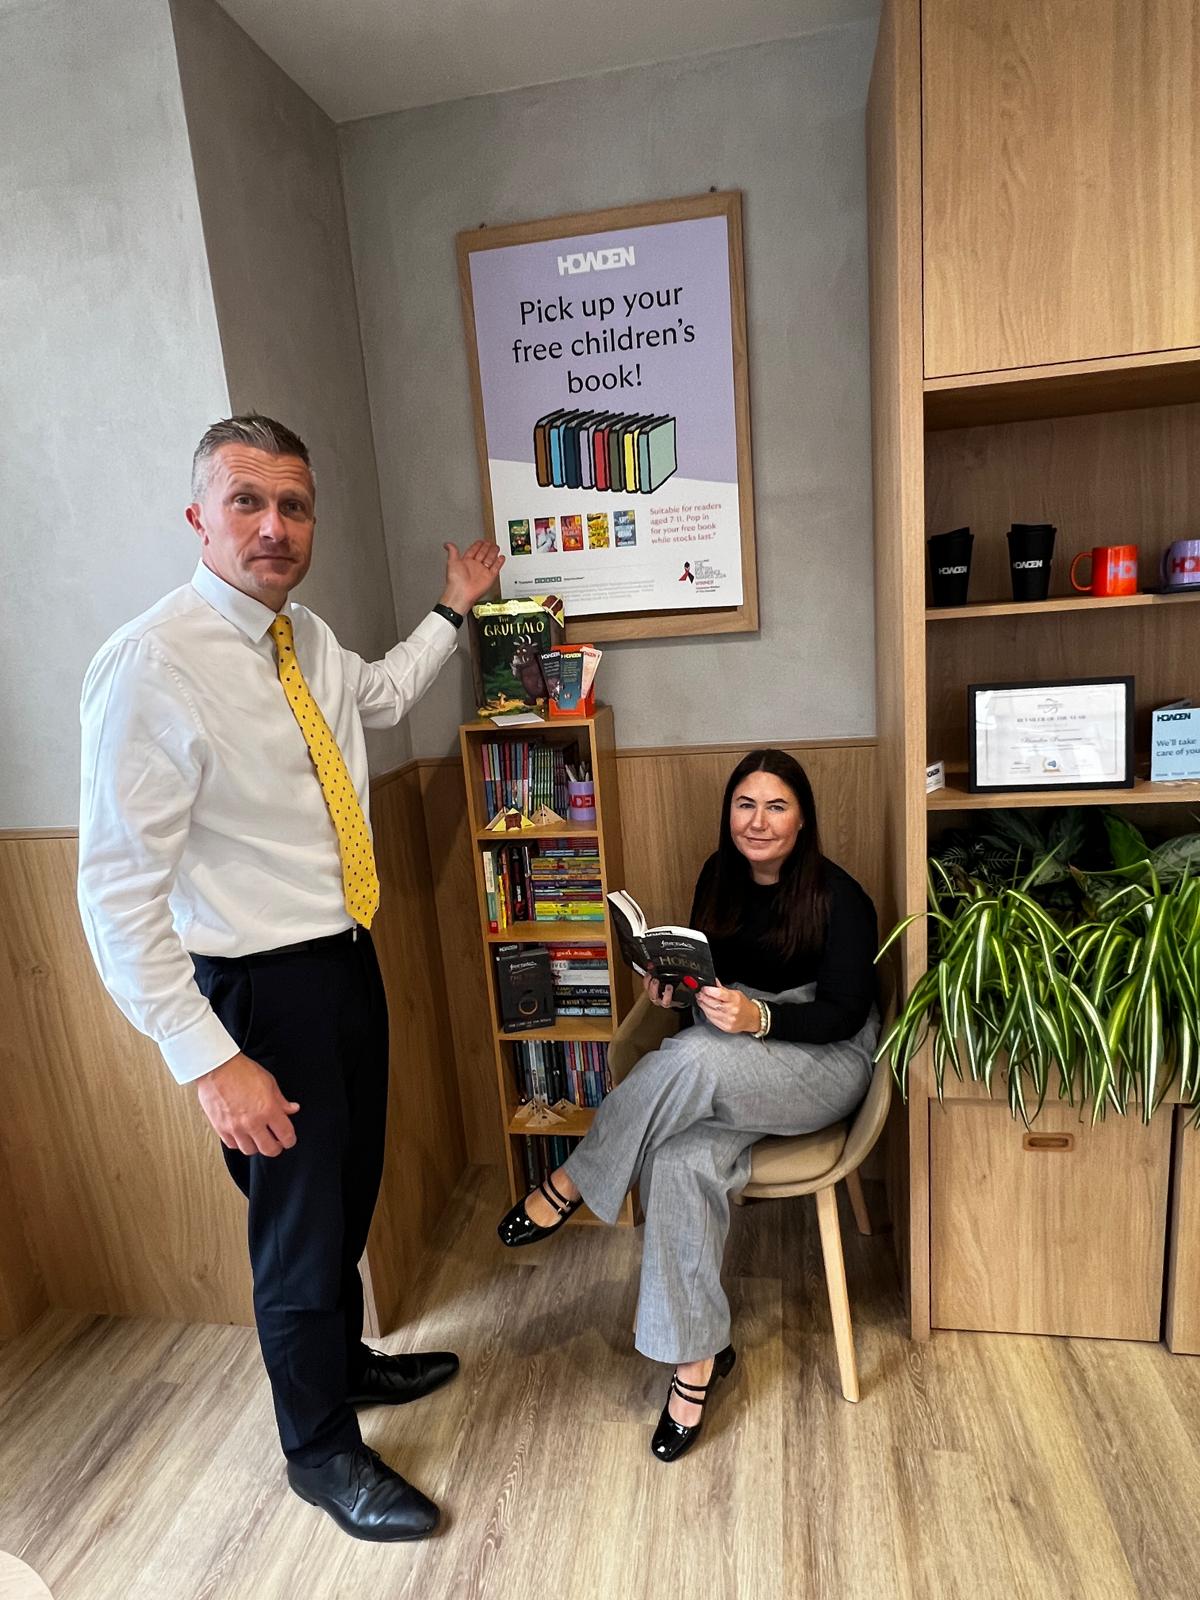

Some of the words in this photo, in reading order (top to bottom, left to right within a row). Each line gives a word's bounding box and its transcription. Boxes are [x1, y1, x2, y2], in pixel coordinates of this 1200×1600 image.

[557, 246, 636, 276] HOWDEN
[520, 296, 574, 325] Pick
[582, 296, 615, 320] up
[623, 287, 684, 317] your
[511, 338, 562, 363] free
[571, 318, 696, 357] children's
[567, 363, 643, 394] book!
[649, 506, 680, 515] Suitable
[694, 503, 722, 511] readers
[650, 517, 668, 526] aged
[686, 514, 701, 523] Pop
[650, 527, 661, 535] for
[662, 526, 679, 535] your
[681, 524, 696, 532] free
[697, 522, 716, 531] book
[651, 535, 671, 545] while
[672, 534, 697, 543] stocks
[938, 566, 968, 575] HOWDEN
[484, 621, 545, 637] GRUFFALO
[1156, 712, 1191, 722] HOWDEN
[1156, 739, 1177, 747] We'll
